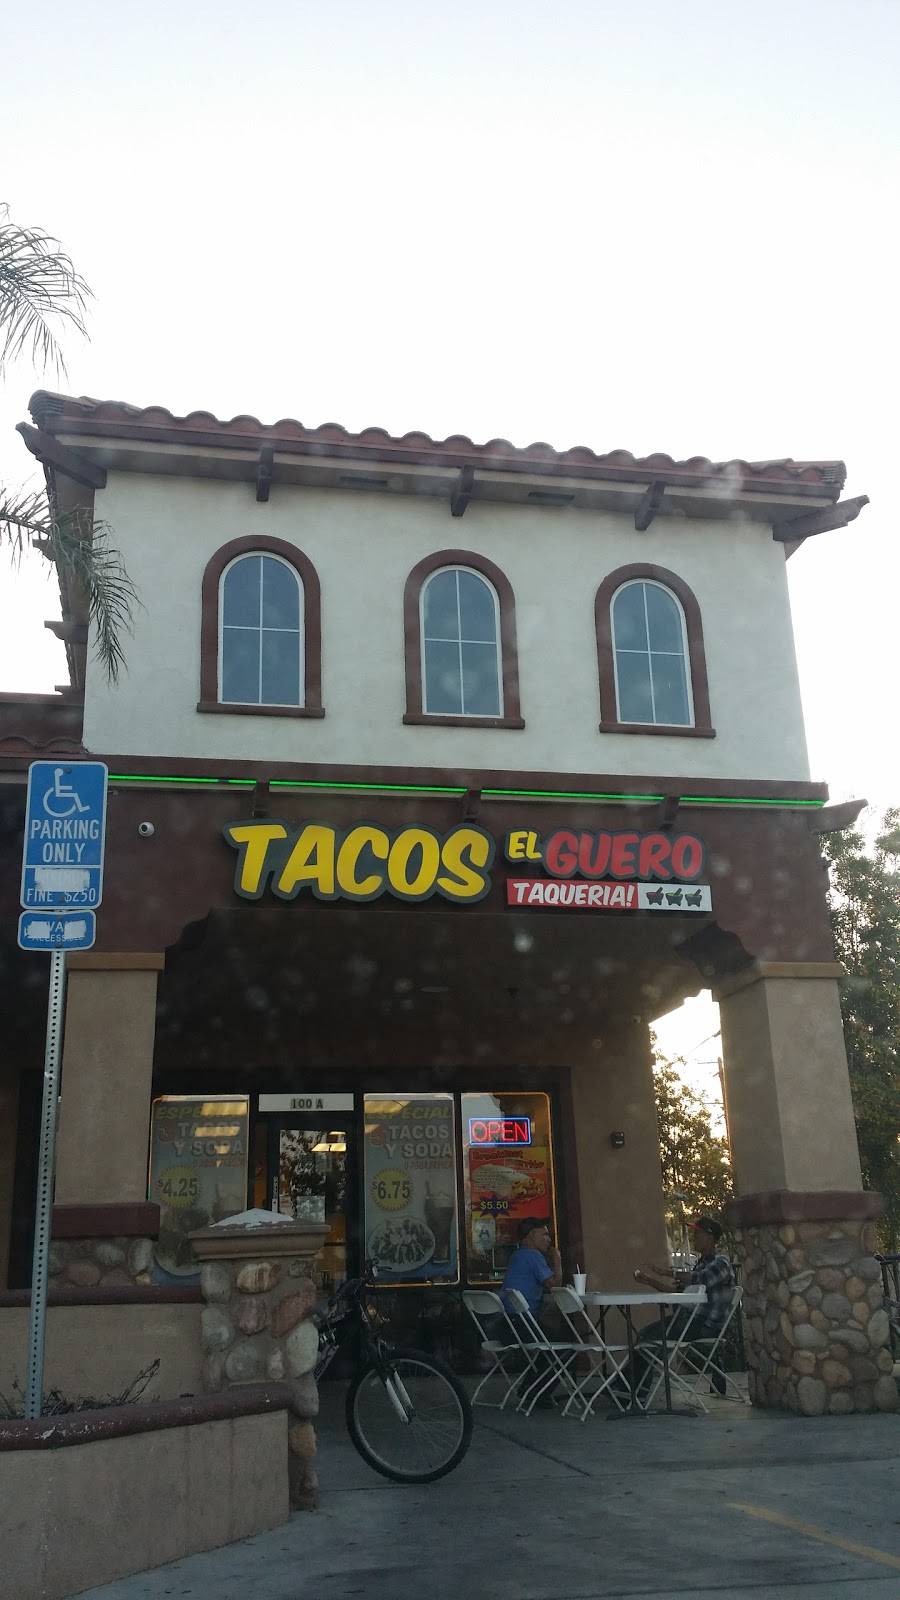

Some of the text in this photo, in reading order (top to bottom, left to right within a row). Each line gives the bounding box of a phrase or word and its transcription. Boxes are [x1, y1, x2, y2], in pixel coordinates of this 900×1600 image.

[31, 819, 100, 840] PARKING
[42, 842, 85, 863] ONLY
[229, 824, 704, 897] TACOS EL GUERO
[27, 888, 96, 903] FINE $250
[513, 882, 635, 907] TAQUERIA!
[291, 1098, 324, 1109] 100 A
[388, 1124, 449, 1140] TACOS
[472, 1121, 528, 1142] OPEN
[173, 1139, 185, 1157] Y
[384, 1142, 454, 1159] Y SODA
[158, 1177, 198, 1197] $4.25
[372, 1180, 410, 1199] $6.75
[480, 1200, 508, 1210] $5.50
